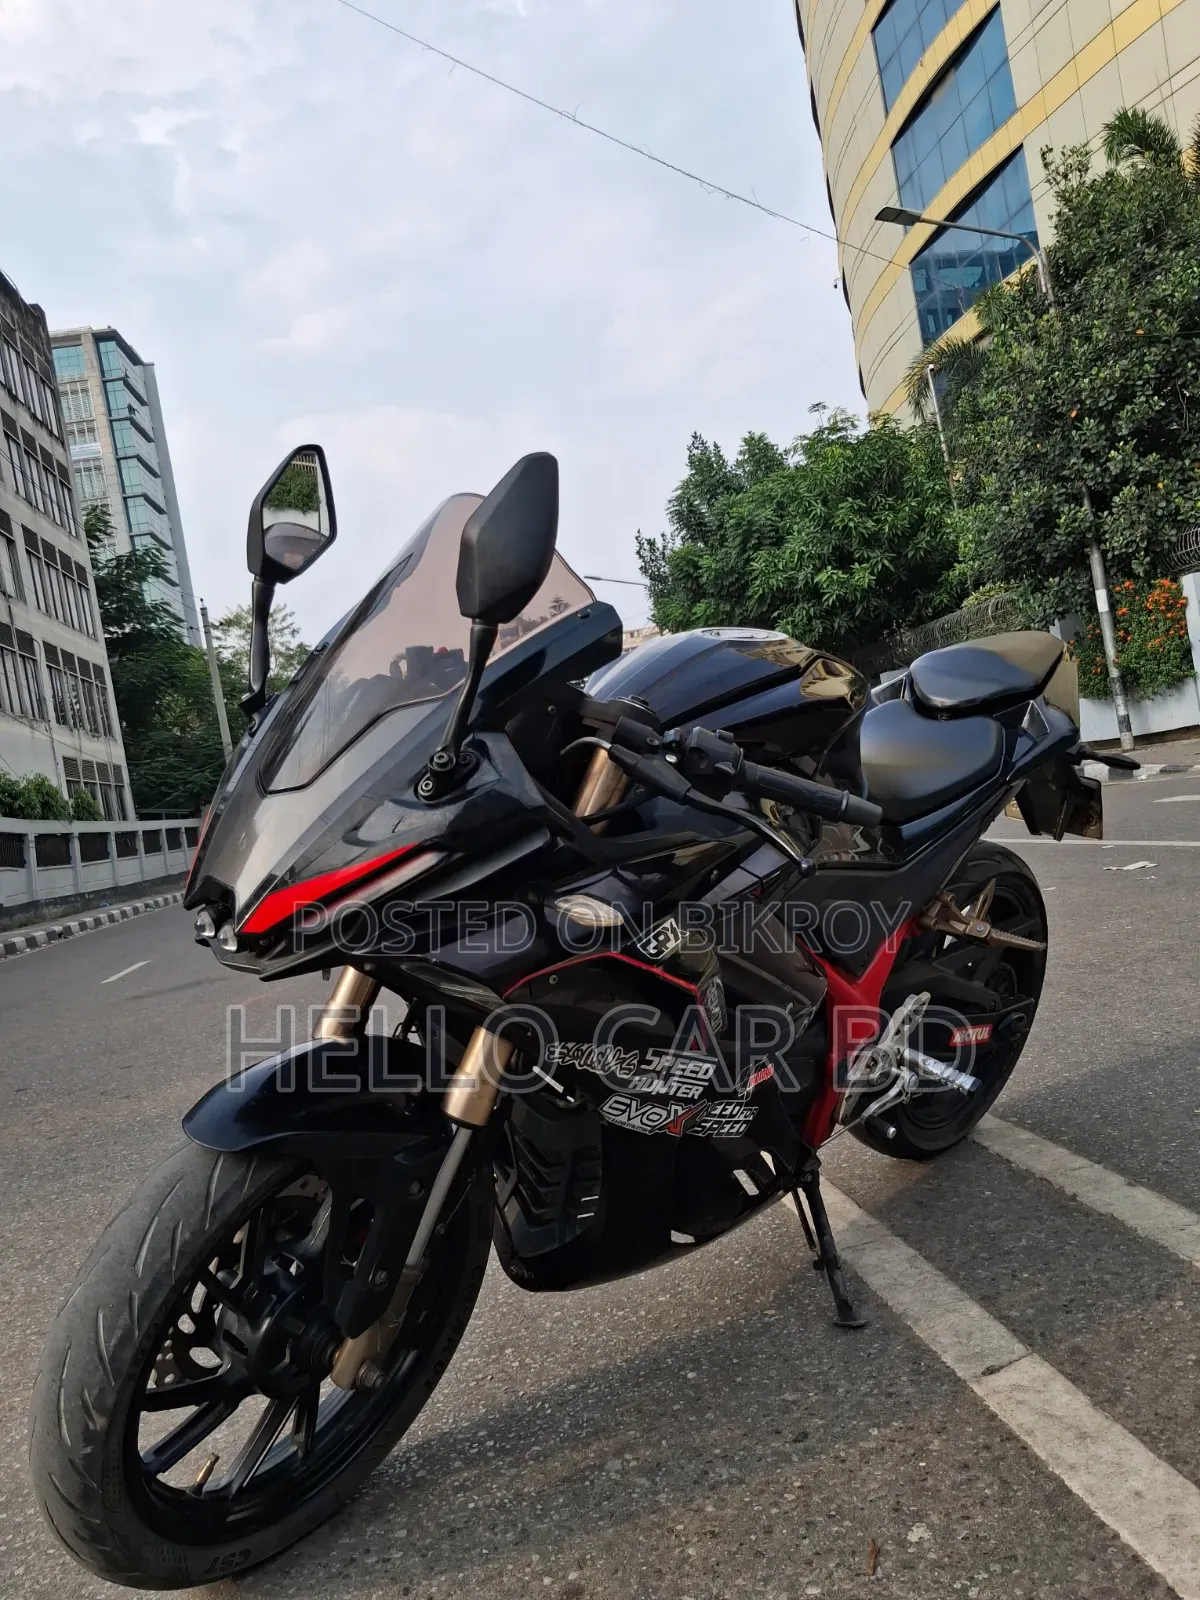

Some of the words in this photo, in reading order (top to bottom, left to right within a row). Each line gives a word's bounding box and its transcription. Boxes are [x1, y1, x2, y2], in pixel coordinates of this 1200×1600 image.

[952, 1027, 990, 1043] MOTUL
[641, 1050, 717, 1080] SPEED
[628, 1075, 704, 1099] HUNTER
[697, 1101, 745, 1120] NEED
[686, 1119, 751, 1138] SPEED
